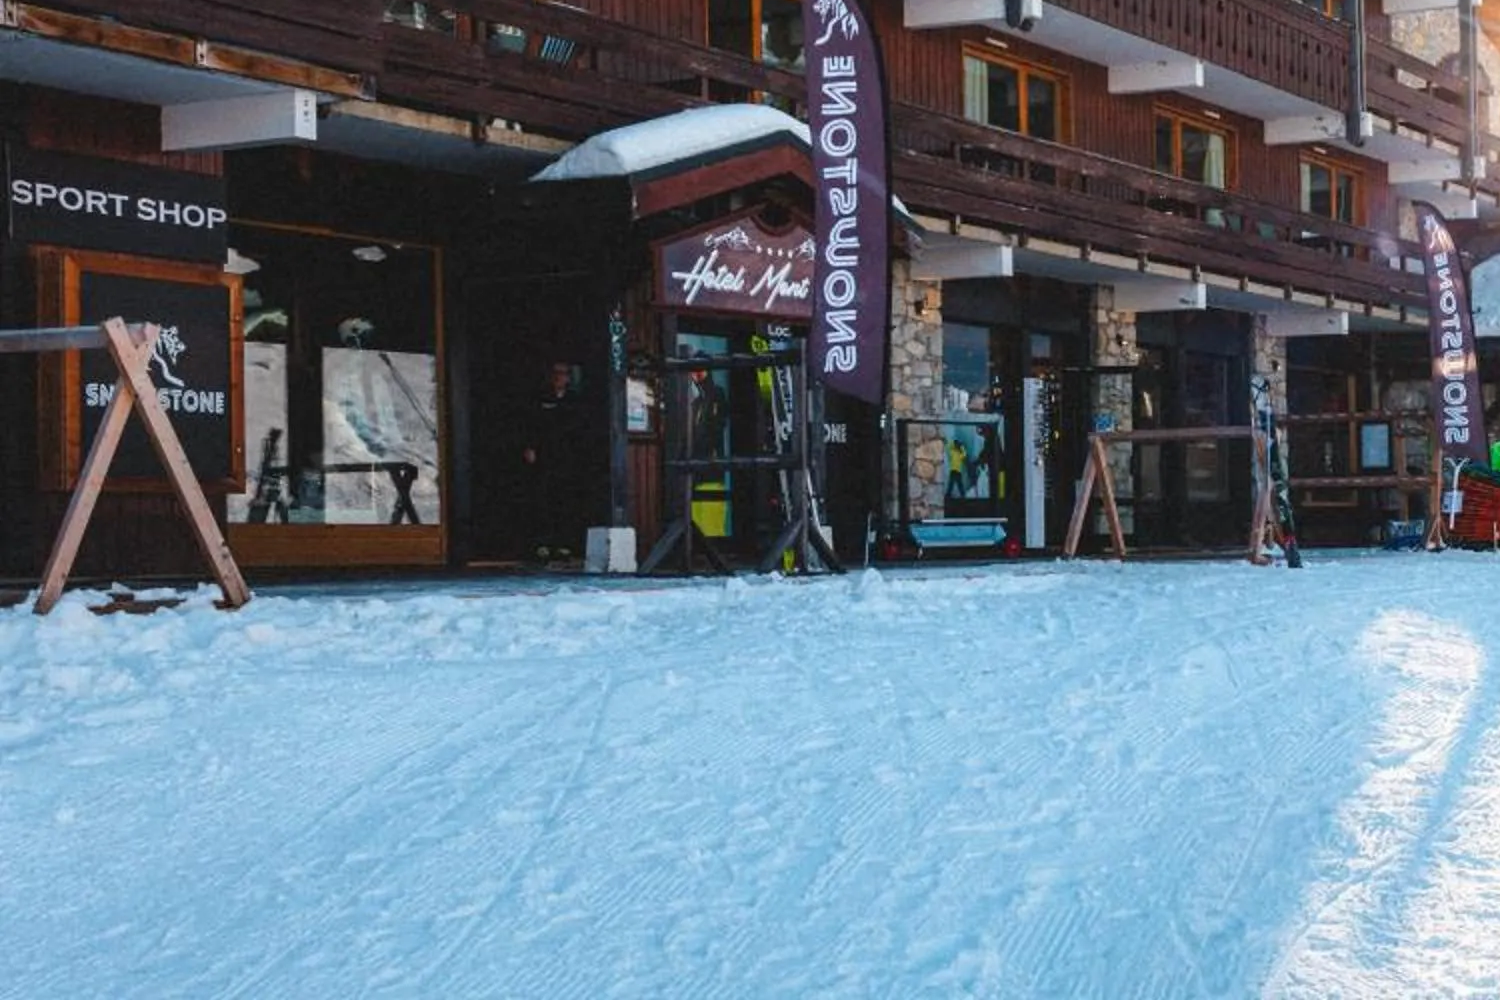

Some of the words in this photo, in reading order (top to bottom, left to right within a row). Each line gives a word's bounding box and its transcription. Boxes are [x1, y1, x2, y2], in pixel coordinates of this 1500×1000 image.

[11, 179, 129, 217] SPORT
[136, 197, 228, 229] SHOP
[671, 249, 745, 305] Hotel
[85, 382, 226, 415] SNSTONE
